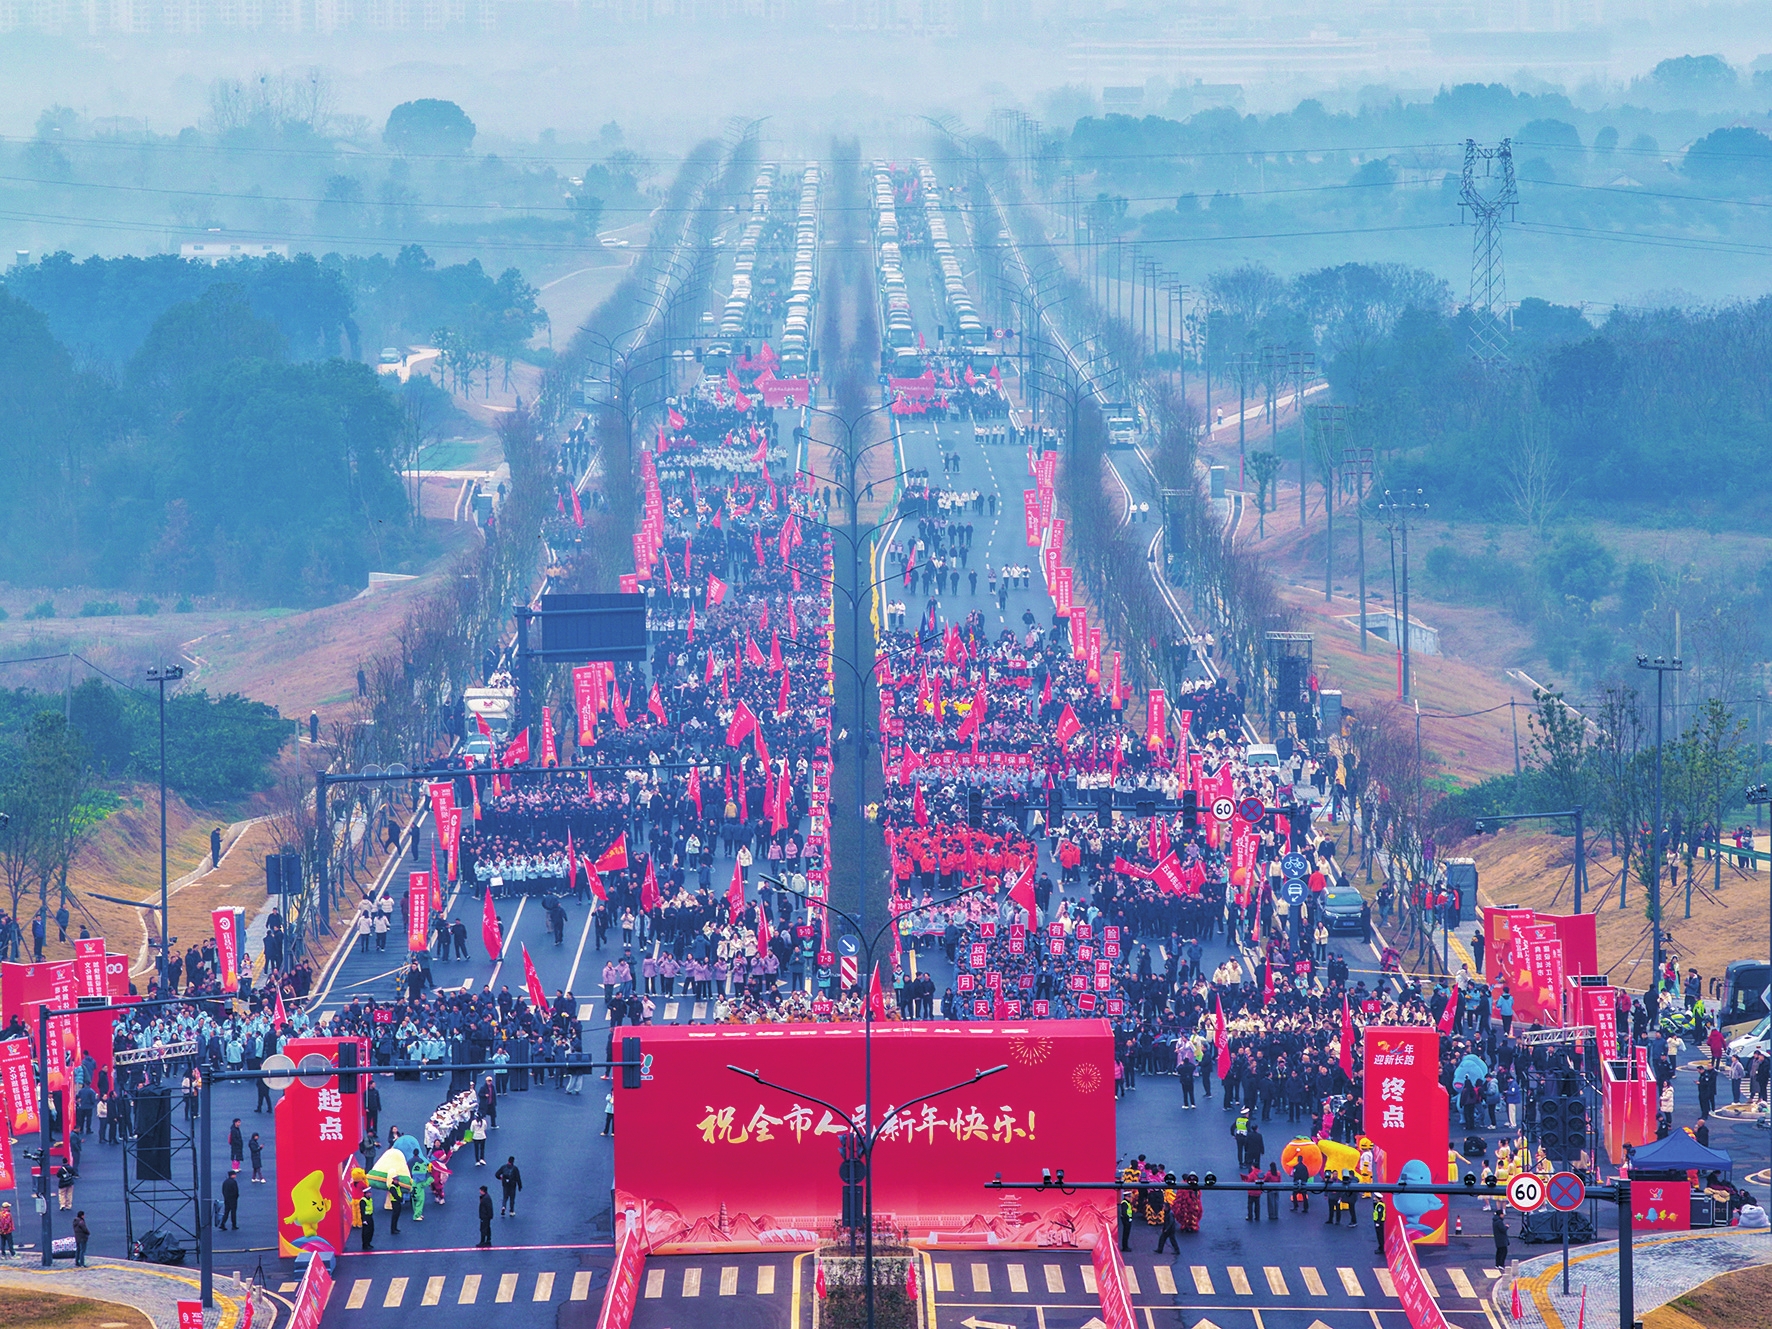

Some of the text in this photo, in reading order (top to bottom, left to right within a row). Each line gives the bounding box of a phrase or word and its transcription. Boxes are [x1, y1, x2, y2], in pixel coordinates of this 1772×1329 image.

[1216, 804, 1231, 815] 60
[814, 1004, 830, 1012] 74-75
[376, 1012, 389, 1021] 5-6
[1374, 1054, 1415, 1066] 迎新长跑
[1381, 1076, 1406, 1128] 终点
[318, 1088, 342, 1141] 起点
[696, 1104, 1036, 1146] 祝全市人民新年快乐!
[1515, 1182, 1537, 1202] 60
